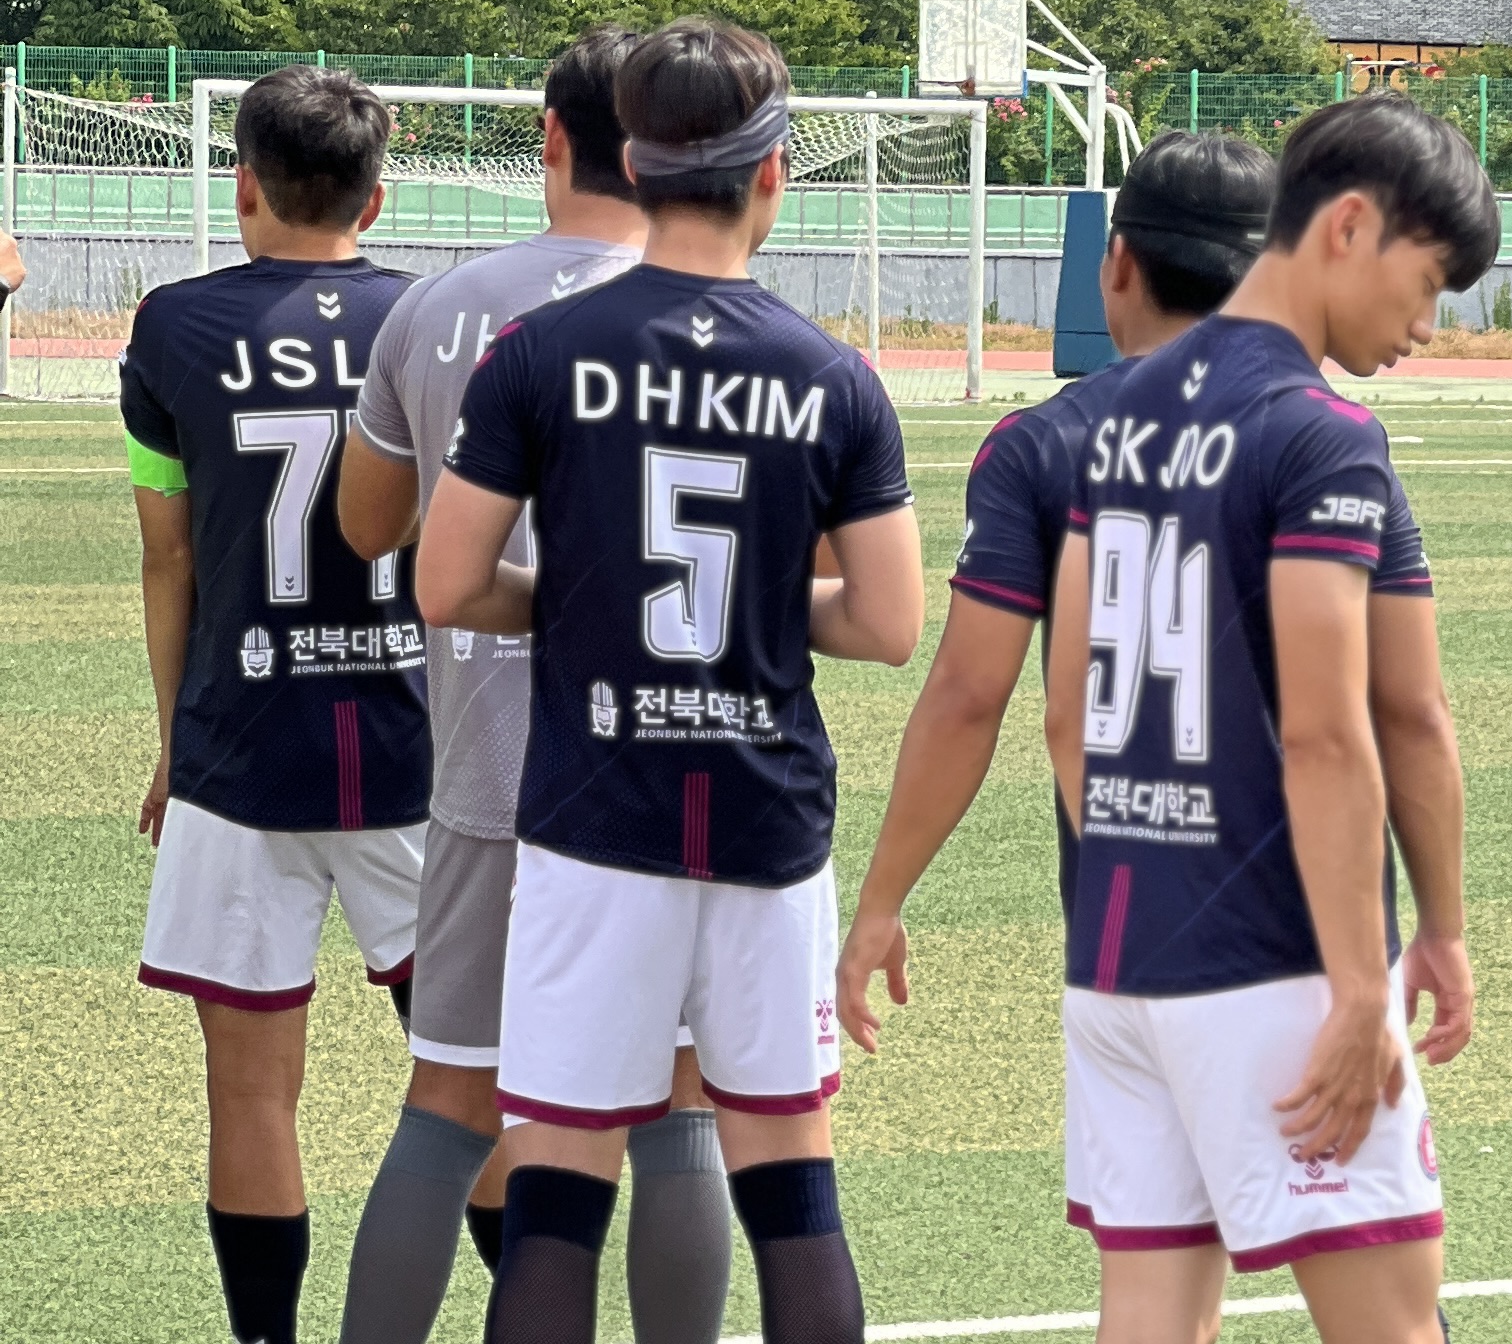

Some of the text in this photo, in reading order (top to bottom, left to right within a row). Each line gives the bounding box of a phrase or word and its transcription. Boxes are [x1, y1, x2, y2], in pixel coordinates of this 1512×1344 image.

[644, 446, 746, 662] 5
[289, 624, 424, 660] 전북대학교
[1084, 509, 1208, 761] 94
[291, 664, 334, 674] JEONBUK
[337, 662, 387, 672] NATIONAL
[635, 728, 687, 739] JEONBUK
[738, 732, 782, 744] ERSITY
[1086, 777, 1216, 826] 전북대학교
[1287, 1178, 1350, 1197] hummel
